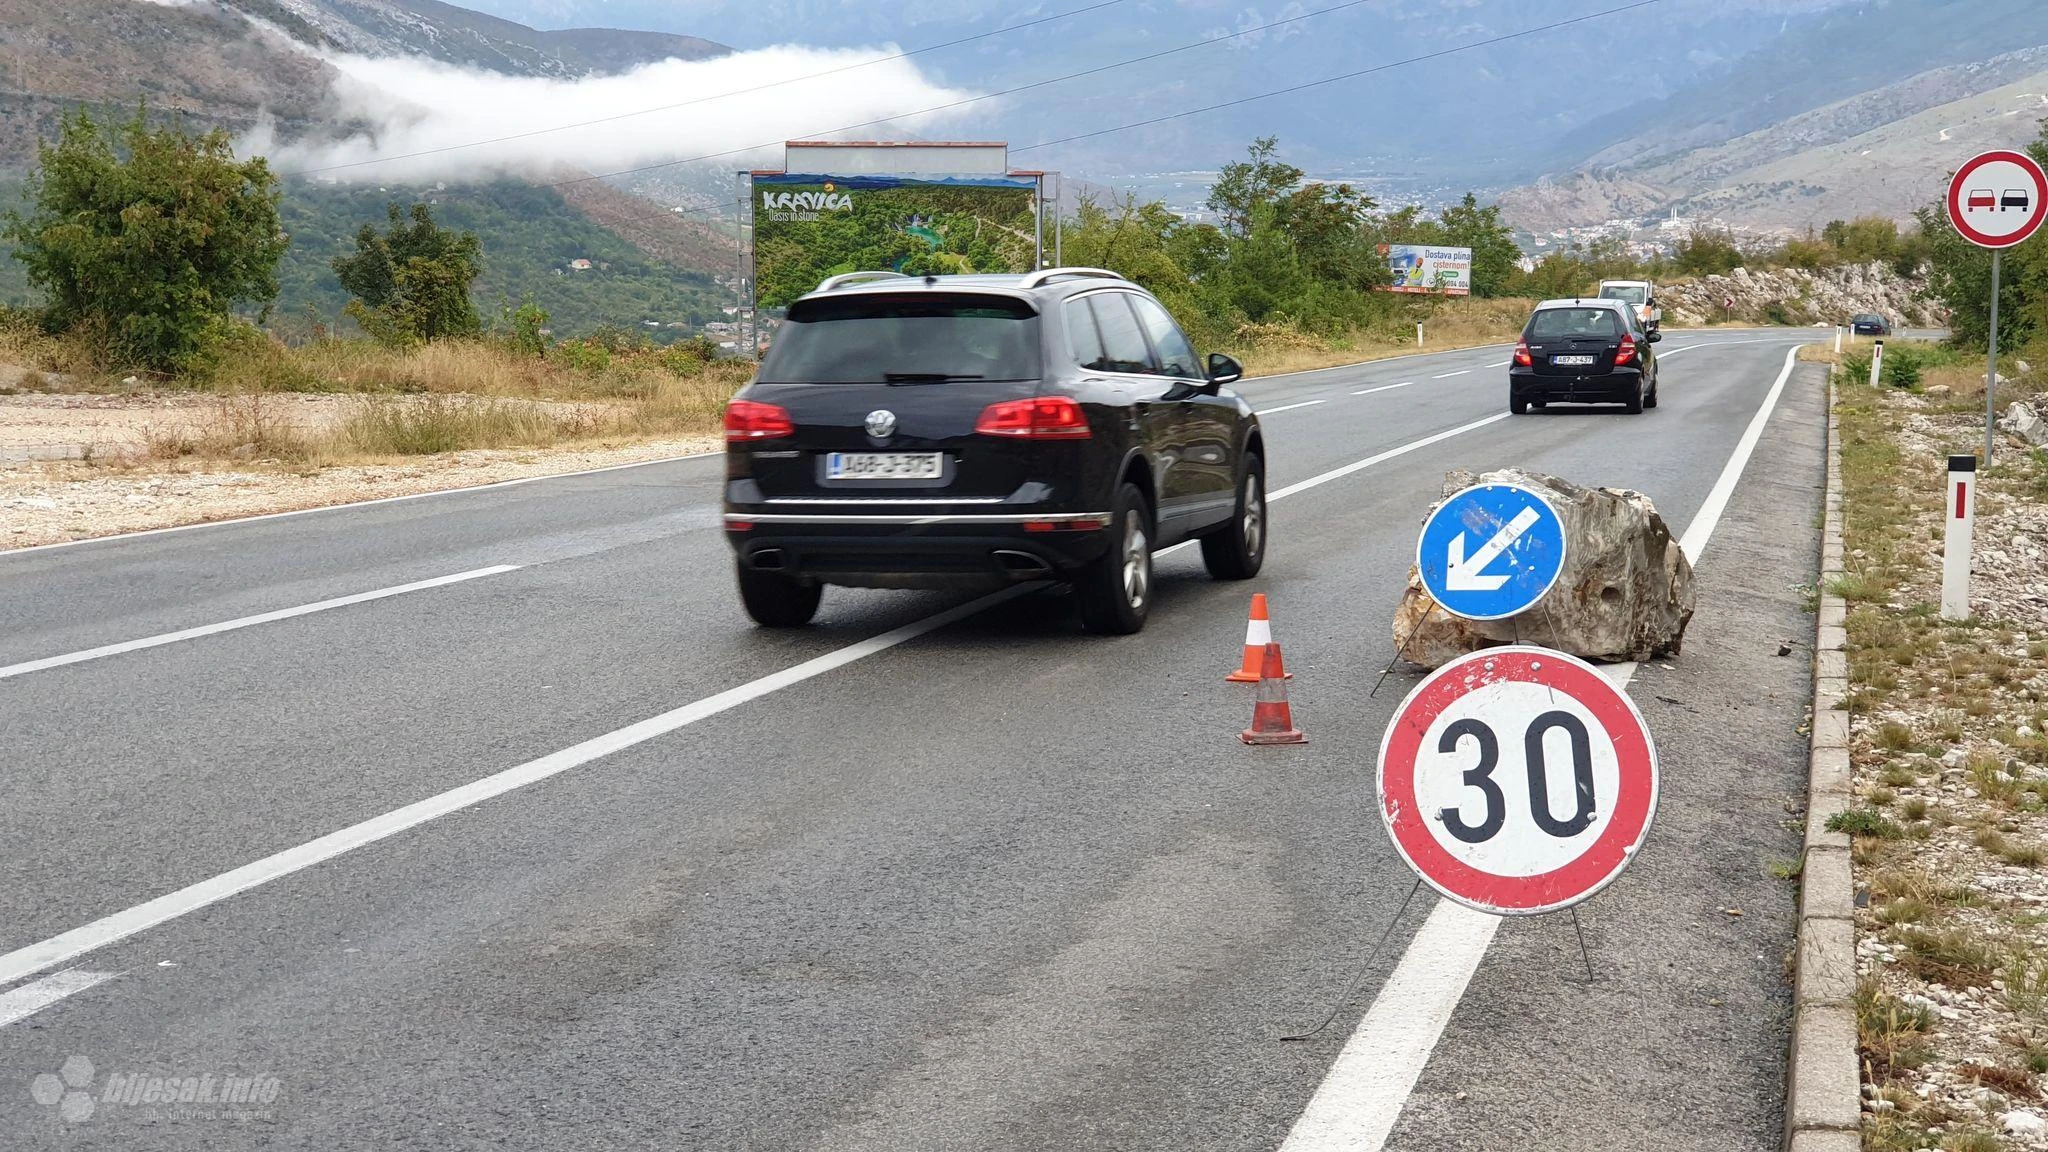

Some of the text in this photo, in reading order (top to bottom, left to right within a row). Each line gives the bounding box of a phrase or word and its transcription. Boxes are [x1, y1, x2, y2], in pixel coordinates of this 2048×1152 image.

[769, 209, 820, 222] Oasis in stone
[1425, 249, 1471, 262] Dostava plina
[1438, 710, 1596, 843] 30
